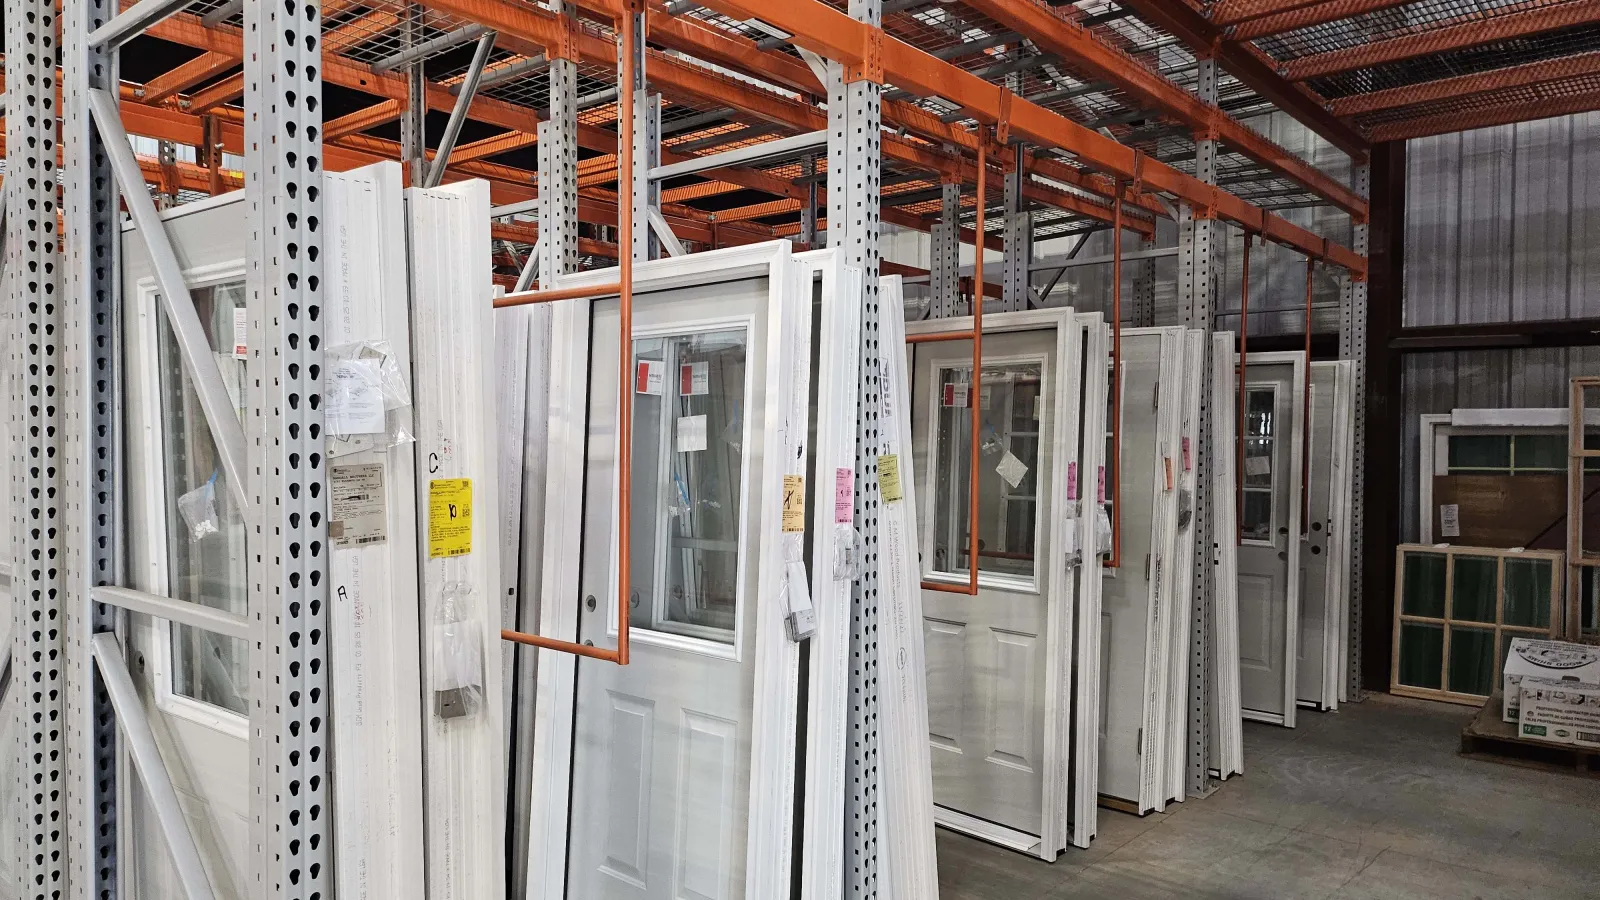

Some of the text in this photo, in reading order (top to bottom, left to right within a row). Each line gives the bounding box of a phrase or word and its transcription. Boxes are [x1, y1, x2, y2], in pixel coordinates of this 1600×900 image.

[341, 251, 347, 260] IN
[428, 453, 438, 474] C
[337, 585, 348, 601] A
[1528, 655, 1552, 666] SHIMS
